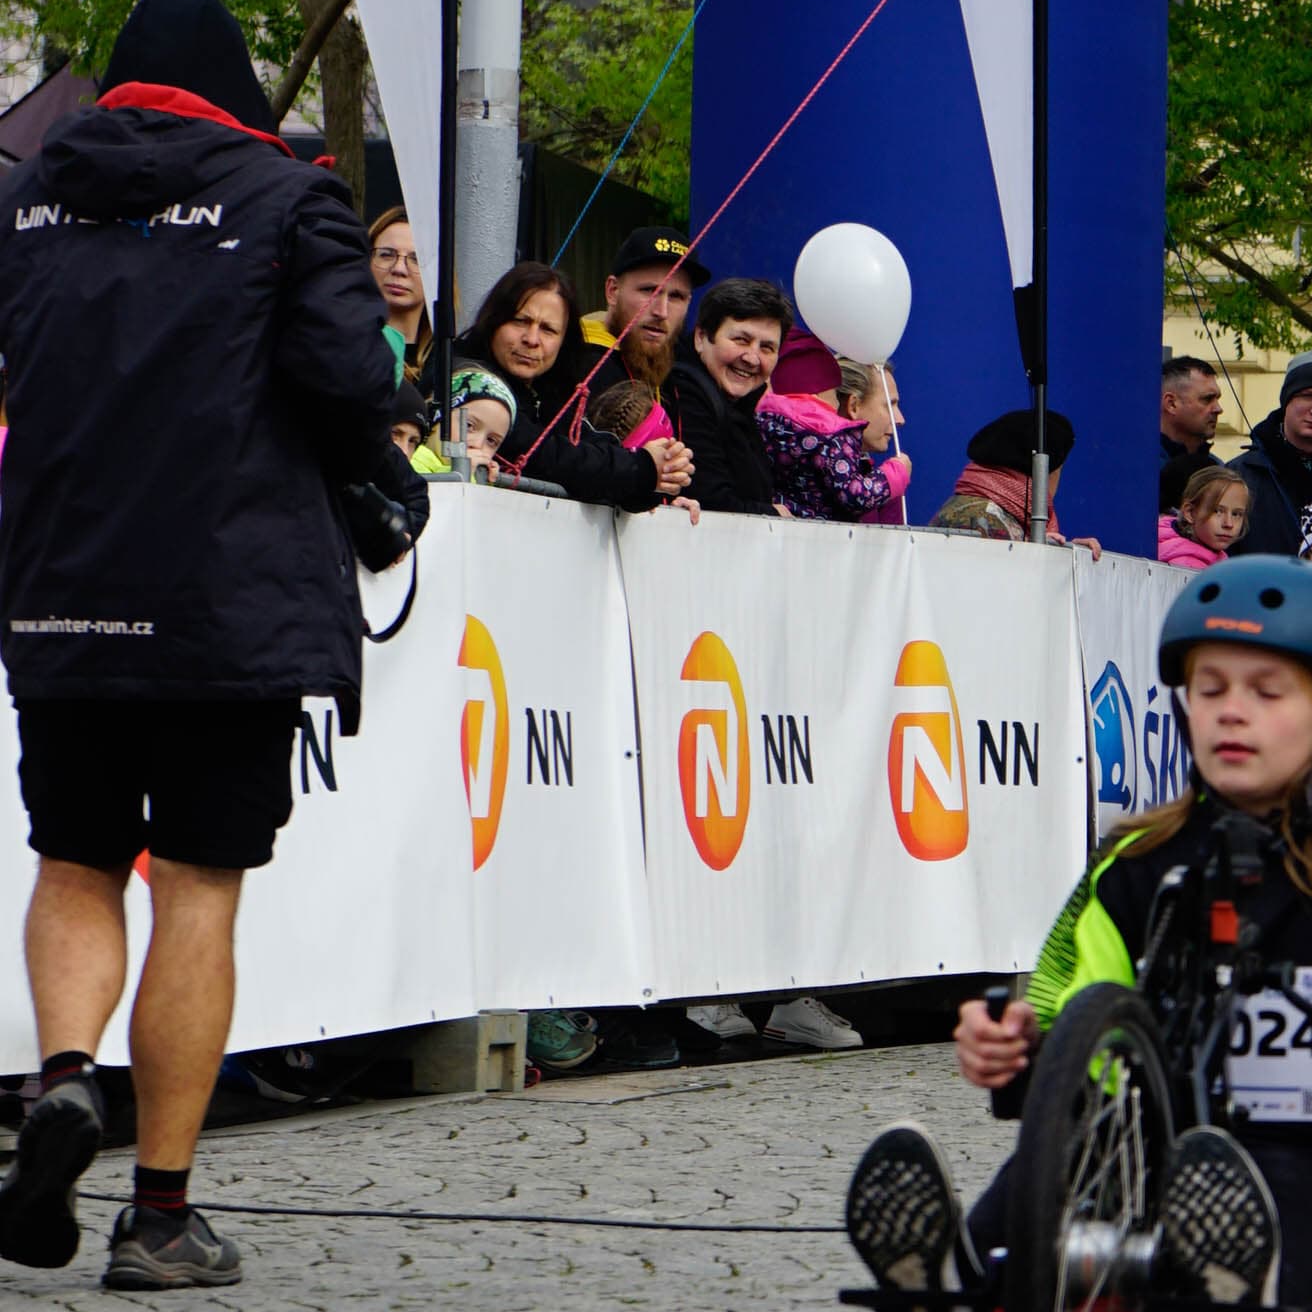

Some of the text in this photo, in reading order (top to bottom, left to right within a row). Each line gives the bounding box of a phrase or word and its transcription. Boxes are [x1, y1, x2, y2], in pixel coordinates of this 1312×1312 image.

[525, 707, 574, 787] NN
[761, 714, 814, 785] NN
[978, 719, 1039, 787] NN
